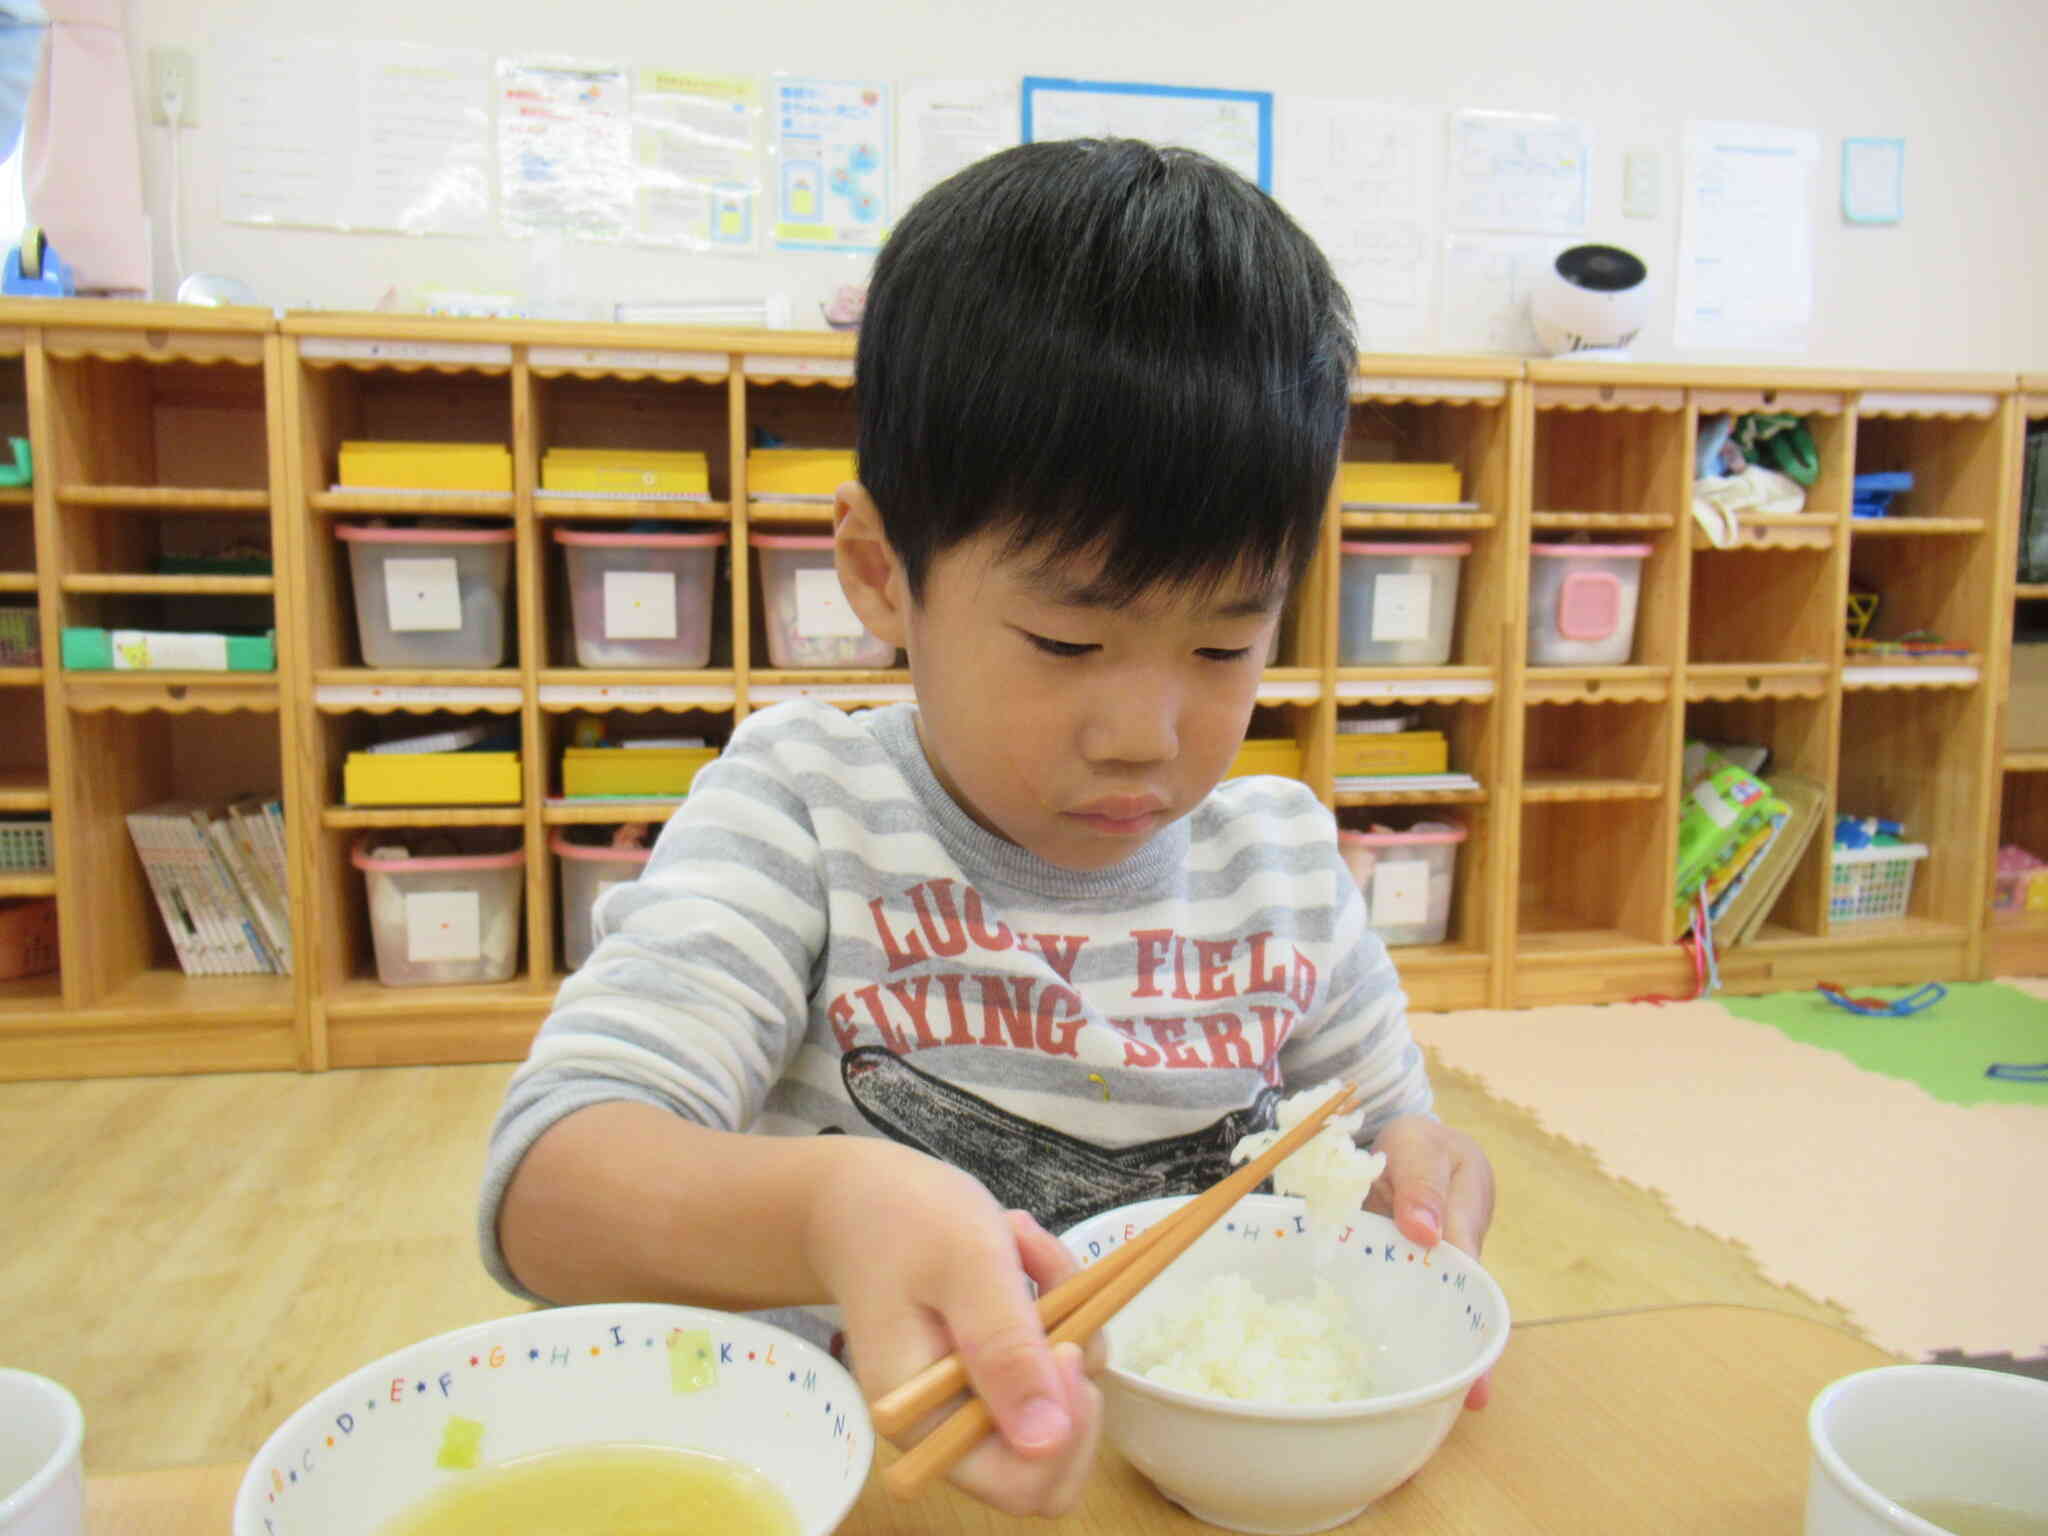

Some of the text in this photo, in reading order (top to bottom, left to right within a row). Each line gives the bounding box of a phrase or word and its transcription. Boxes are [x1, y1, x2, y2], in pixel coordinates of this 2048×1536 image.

[868, 877, 1318, 1014] LUCY FIELD
[827, 973, 1089, 1059] FLYING
[1293, 1215, 1305, 1233] I
[1384, 1244, 1396, 1262] K
[336, 1412, 354, 1434] D
[390, 1377, 405, 1403] E
[439, 1372, 453, 1397] F
[488, 1345, 506, 1369] G
[550, 1345, 570, 1367] H
[609, 1325, 625, 1347] I
[719, 1343, 733, 1365] K
[766, 1343, 776, 1365] L
[832, 1414, 846, 1437] N
